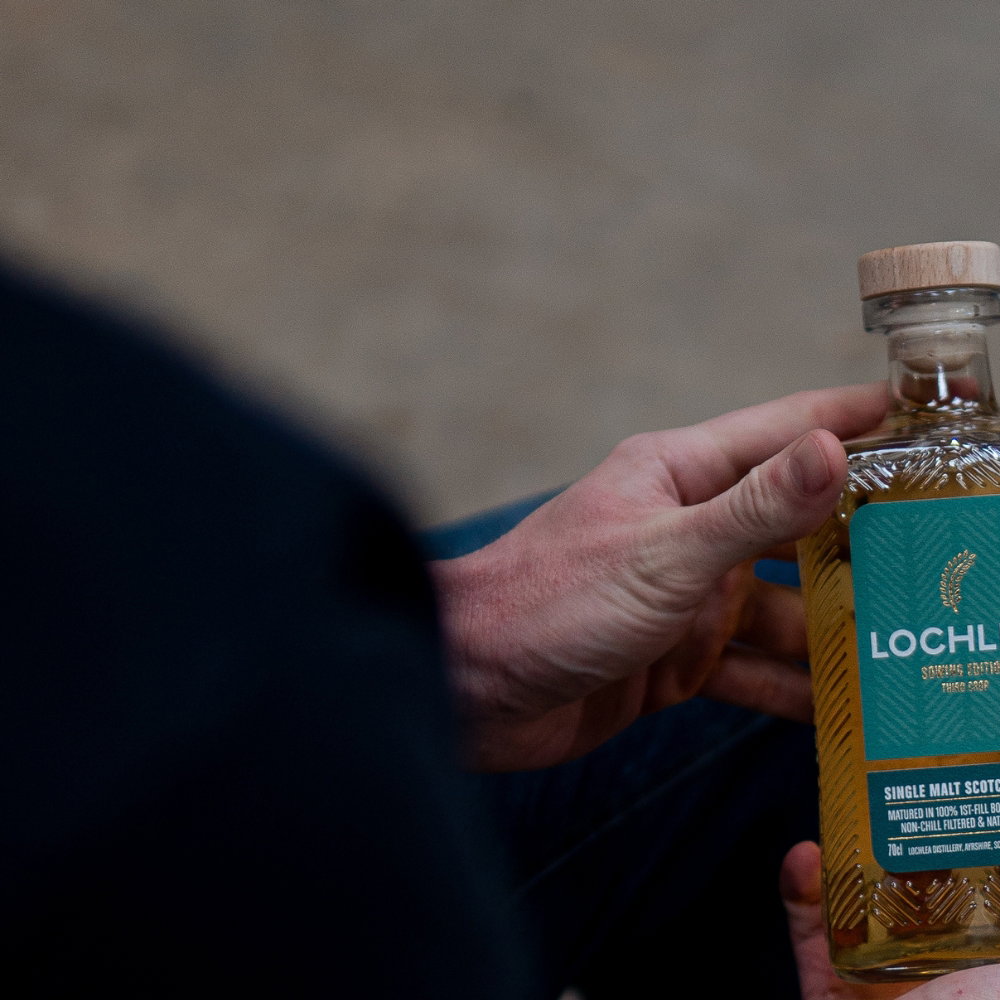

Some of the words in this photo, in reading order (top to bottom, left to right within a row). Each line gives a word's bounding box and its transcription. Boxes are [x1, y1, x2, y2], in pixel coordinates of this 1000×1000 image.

[921, 664, 963, 680] SOWING
[942, 682, 965, 692] THIRD
[969, 680, 989, 691] CROP
[884, 784, 925, 800] SINGLE
[929, 782, 960, 797] MALT
[888, 807, 923, 820] MATURED
[926, 807, 933, 818] IN
[935, 805, 958, 817] 100%
[960, 802, 989, 815] 1ST-FILL
[901, 819, 941, 833] NON-CHILL
[944, 817, 975, 830] FILTERED
[978, 816, 985, 827] &
[888, 843, 903, 856] 70cl
[908, 846, 932, 855] LOCHLEA
[965, 841, 993, 851] AYRSHIRE,
